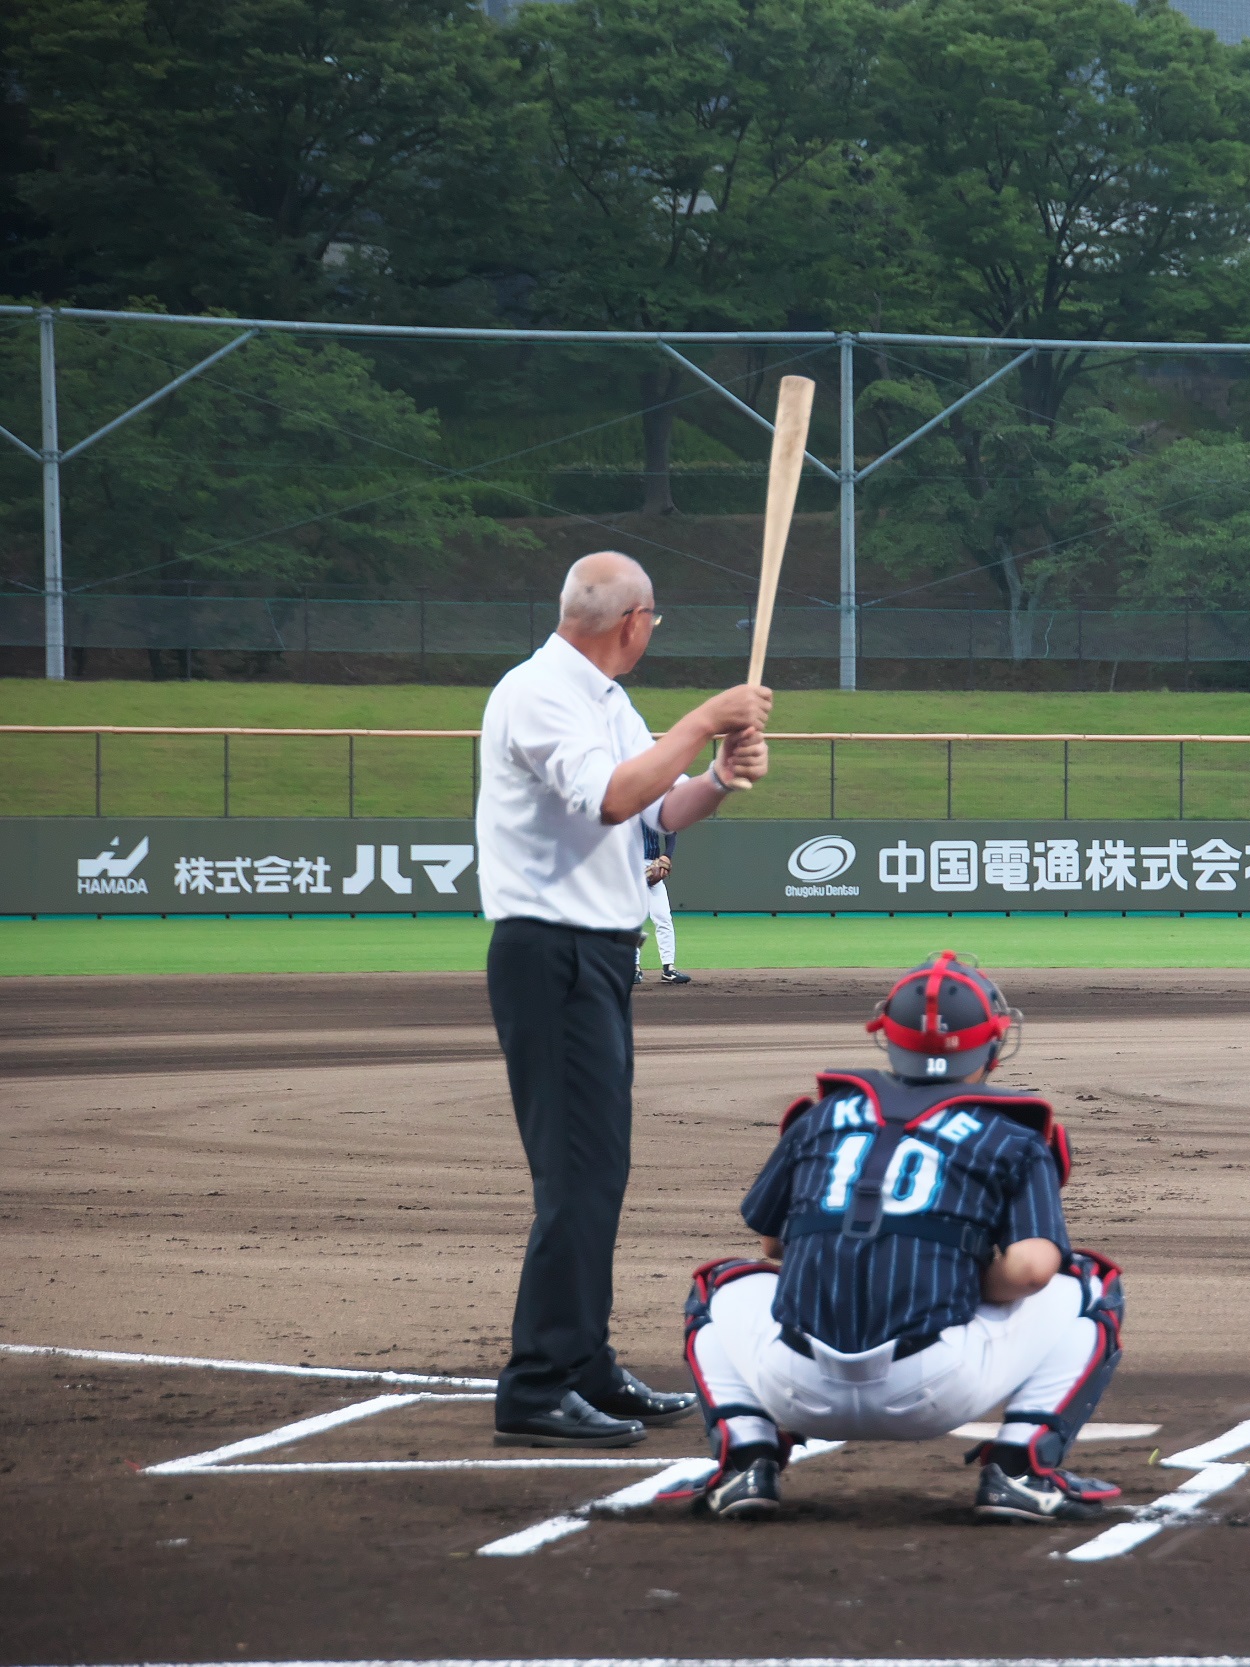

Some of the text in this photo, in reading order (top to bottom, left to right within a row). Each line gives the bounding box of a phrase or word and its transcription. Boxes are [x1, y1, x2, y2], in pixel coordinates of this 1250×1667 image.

[77, 878, 149, 894] HAMADA
[785, 884, 860, 898] Chugoku Dentsu
[927, 1057, 947, 1075] 10
[821, 1132, 945, 1215] 10
